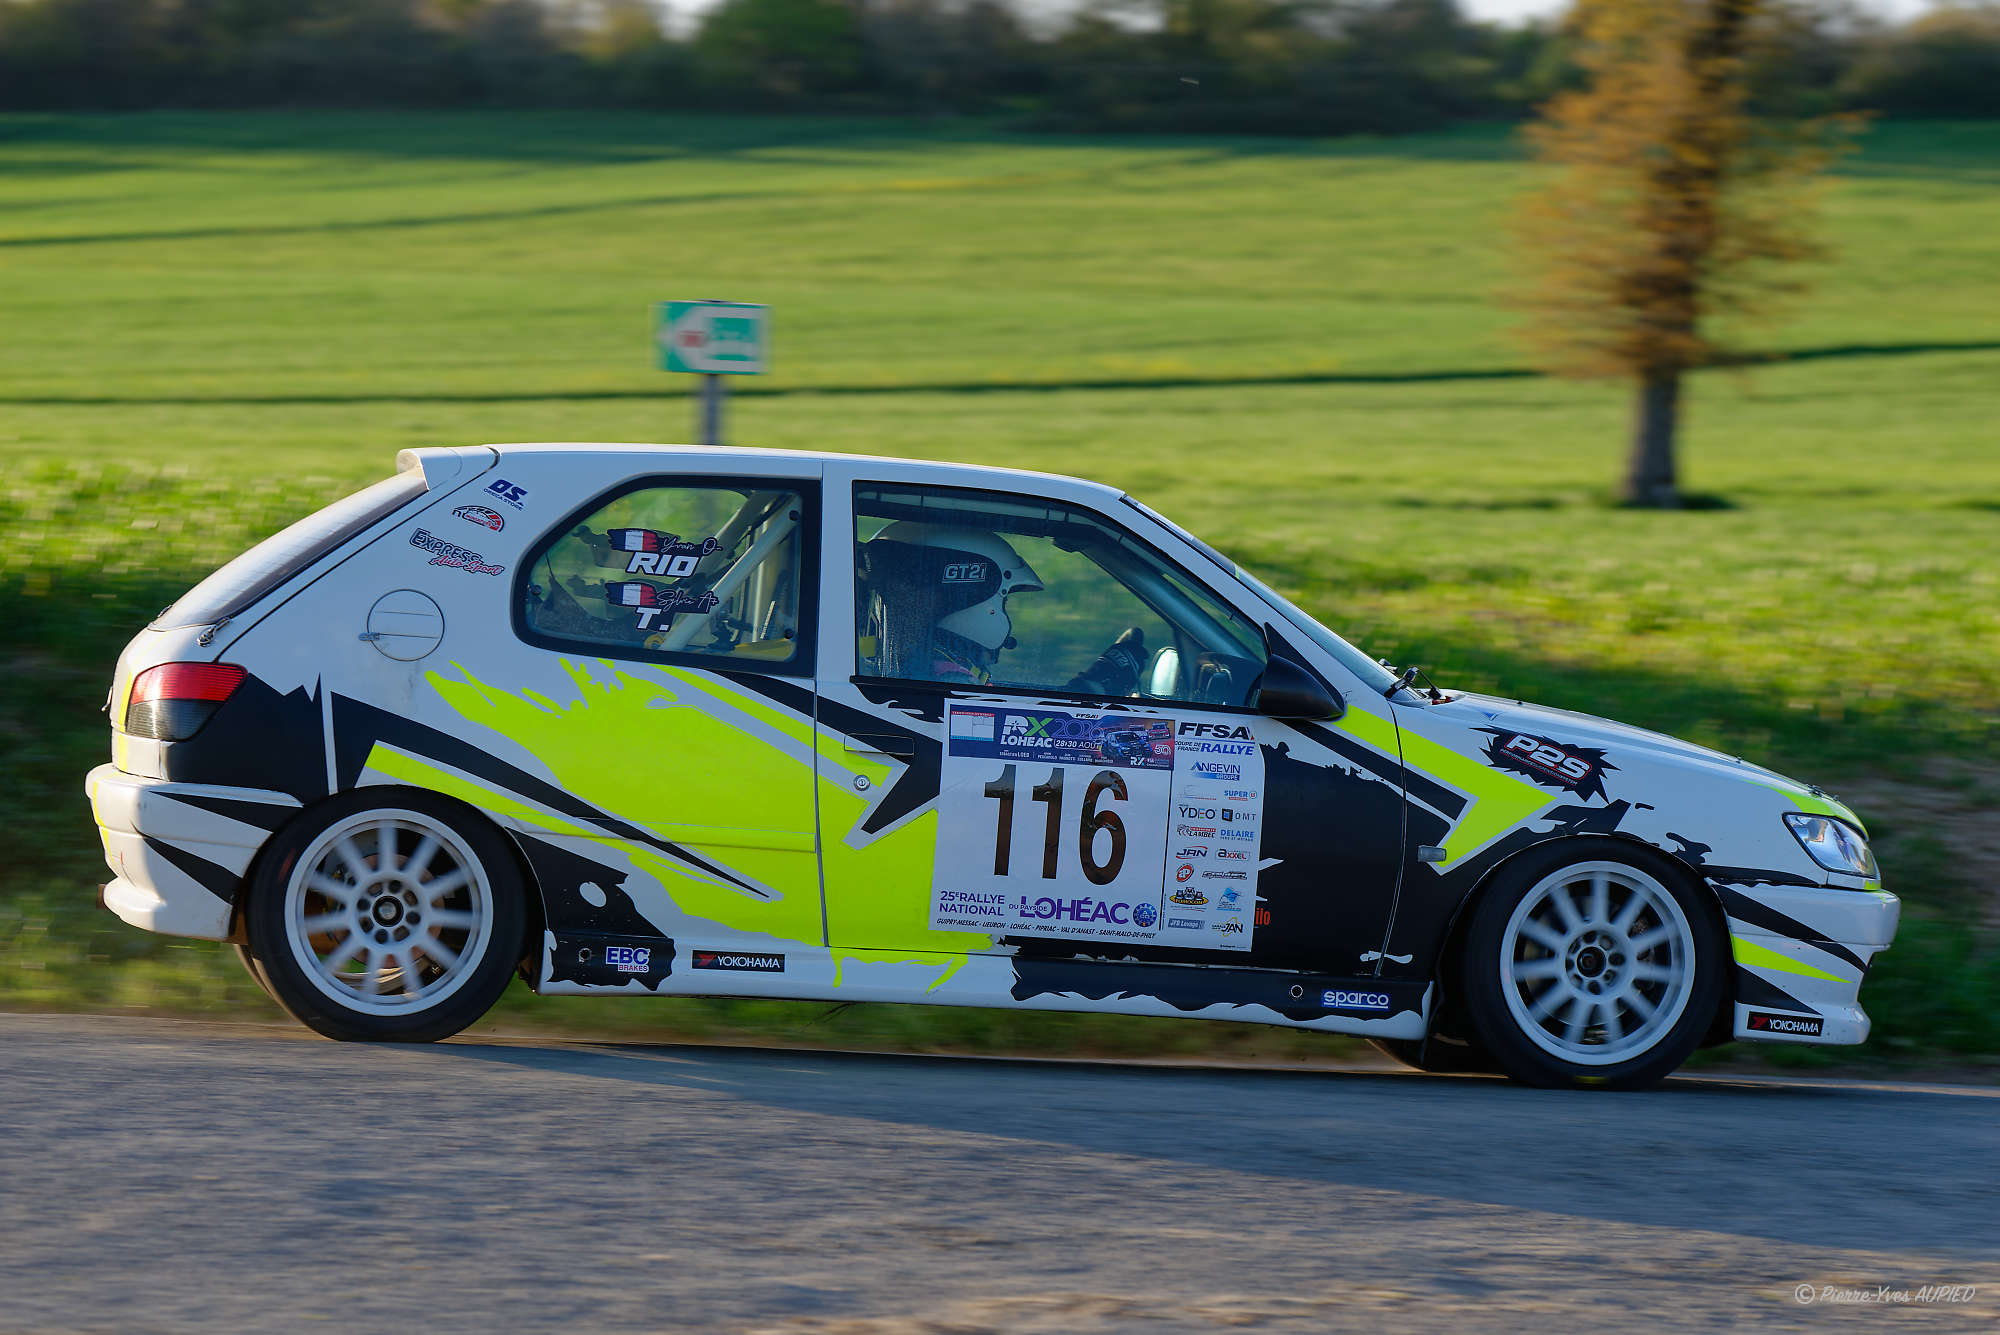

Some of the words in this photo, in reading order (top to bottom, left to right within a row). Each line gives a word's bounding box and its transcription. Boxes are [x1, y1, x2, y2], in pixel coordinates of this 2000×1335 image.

[410, 528, 484, 563] EXPRESS
[626, 551, 700, 577] RIO
[1178, 722, 1250, 740] FFSA
[1000, 735, 1053, 748] LOHEAC
[1200, 743, 1254, 755] RALLYE
[1506, 734, 1590, 779] P2S
[1191, 762, 1240, 774] ANGEVIN
[1224, 790, 1248, 798] SUPER
[983, 763, 1129, 886] 116
[1220, 829, 1254, 838] DELAIRE
[959, 892, 1006, 904] RALLYE
[939, 903, 1005, 916] NATIONAL
[1020, 896, 1130, 925] LOHÉAC
[606, 947, 649, 964] EBC
[717, 955, 780, 968] YOKOHAMA
[618, 964, 648, 972] BRAKES
[1323, 990, 1389, 1007] sparco
[1769, 1018, 1819, 1033] YOKOHAMA
